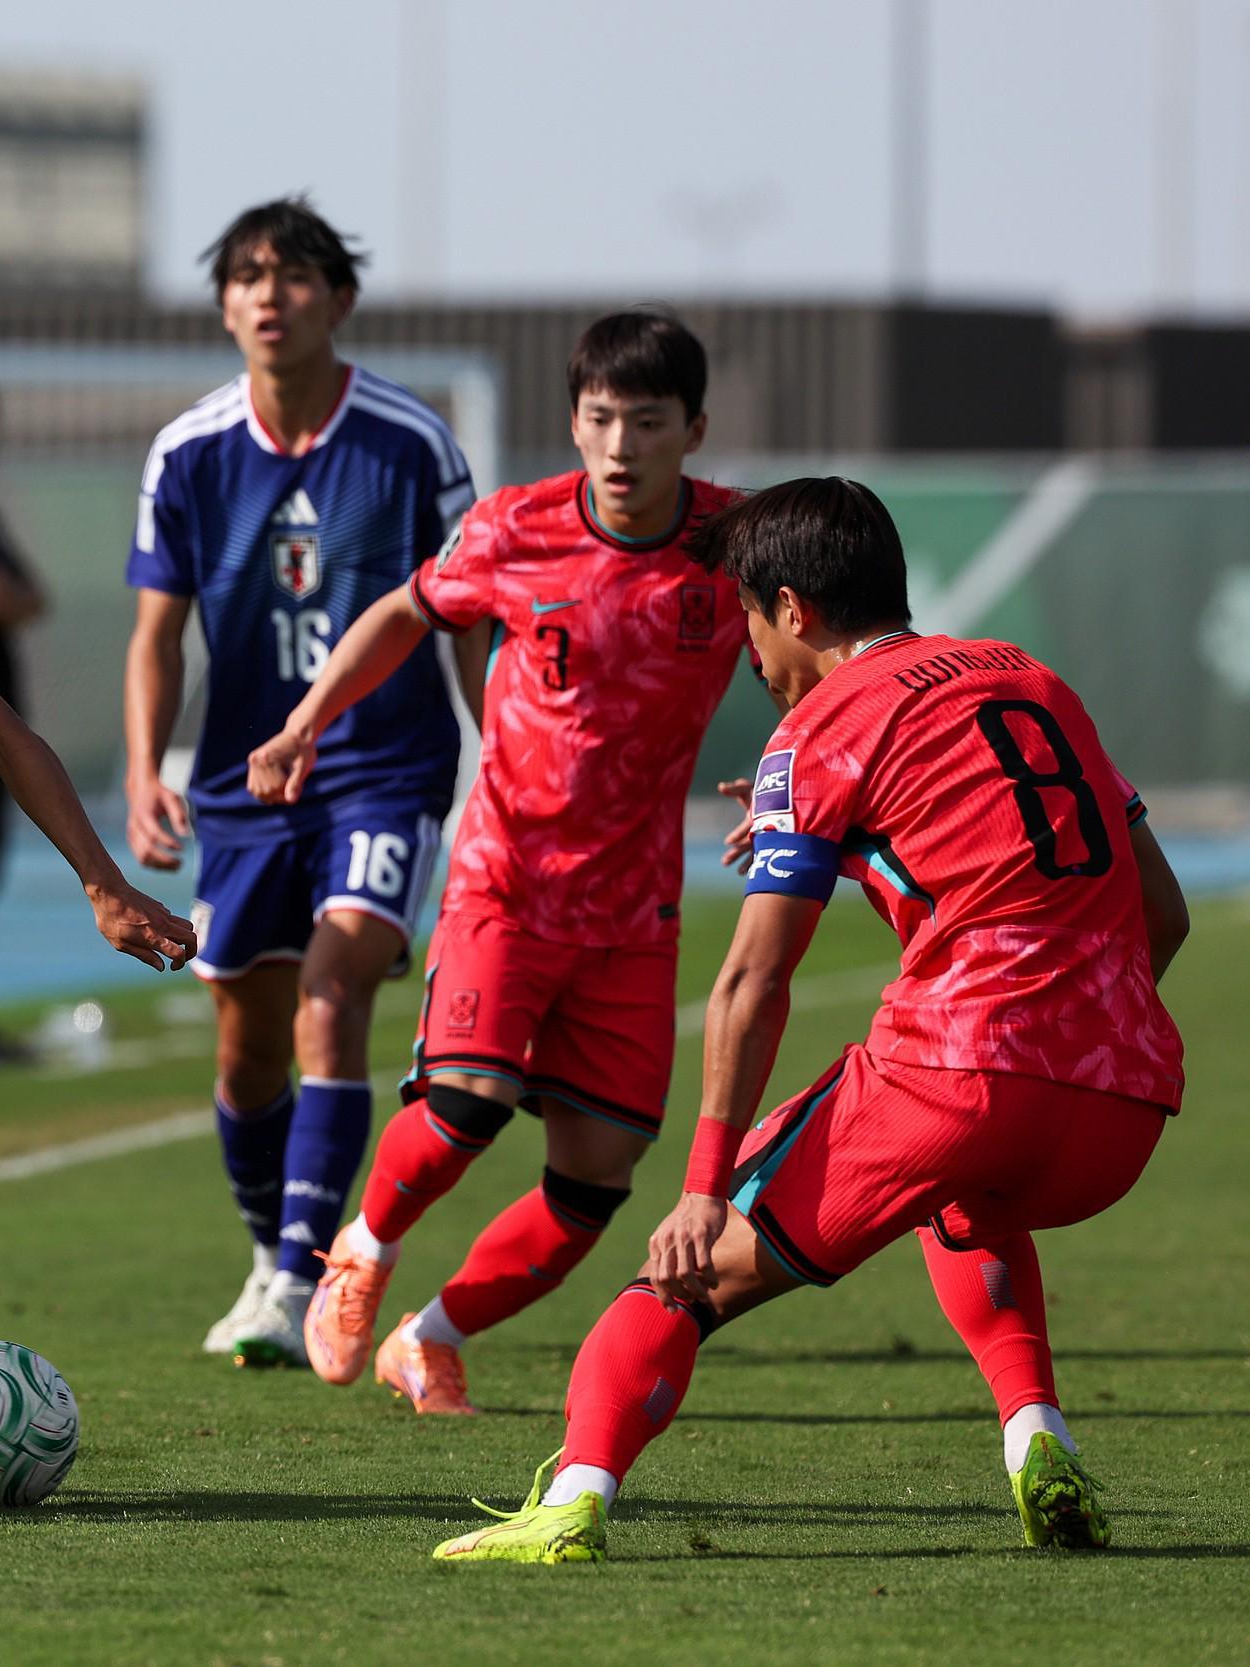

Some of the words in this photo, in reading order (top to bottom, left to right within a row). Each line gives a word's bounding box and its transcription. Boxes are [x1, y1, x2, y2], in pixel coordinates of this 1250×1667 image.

[270, 607, 332, 683] 16
[536, 624, 570, 692] 3
[756, 770, 788, 792] AFC
[976, 699, 1113, 881] 8
[346, 830, 410, 899] 16
[748, 848, 799, 880] FC
